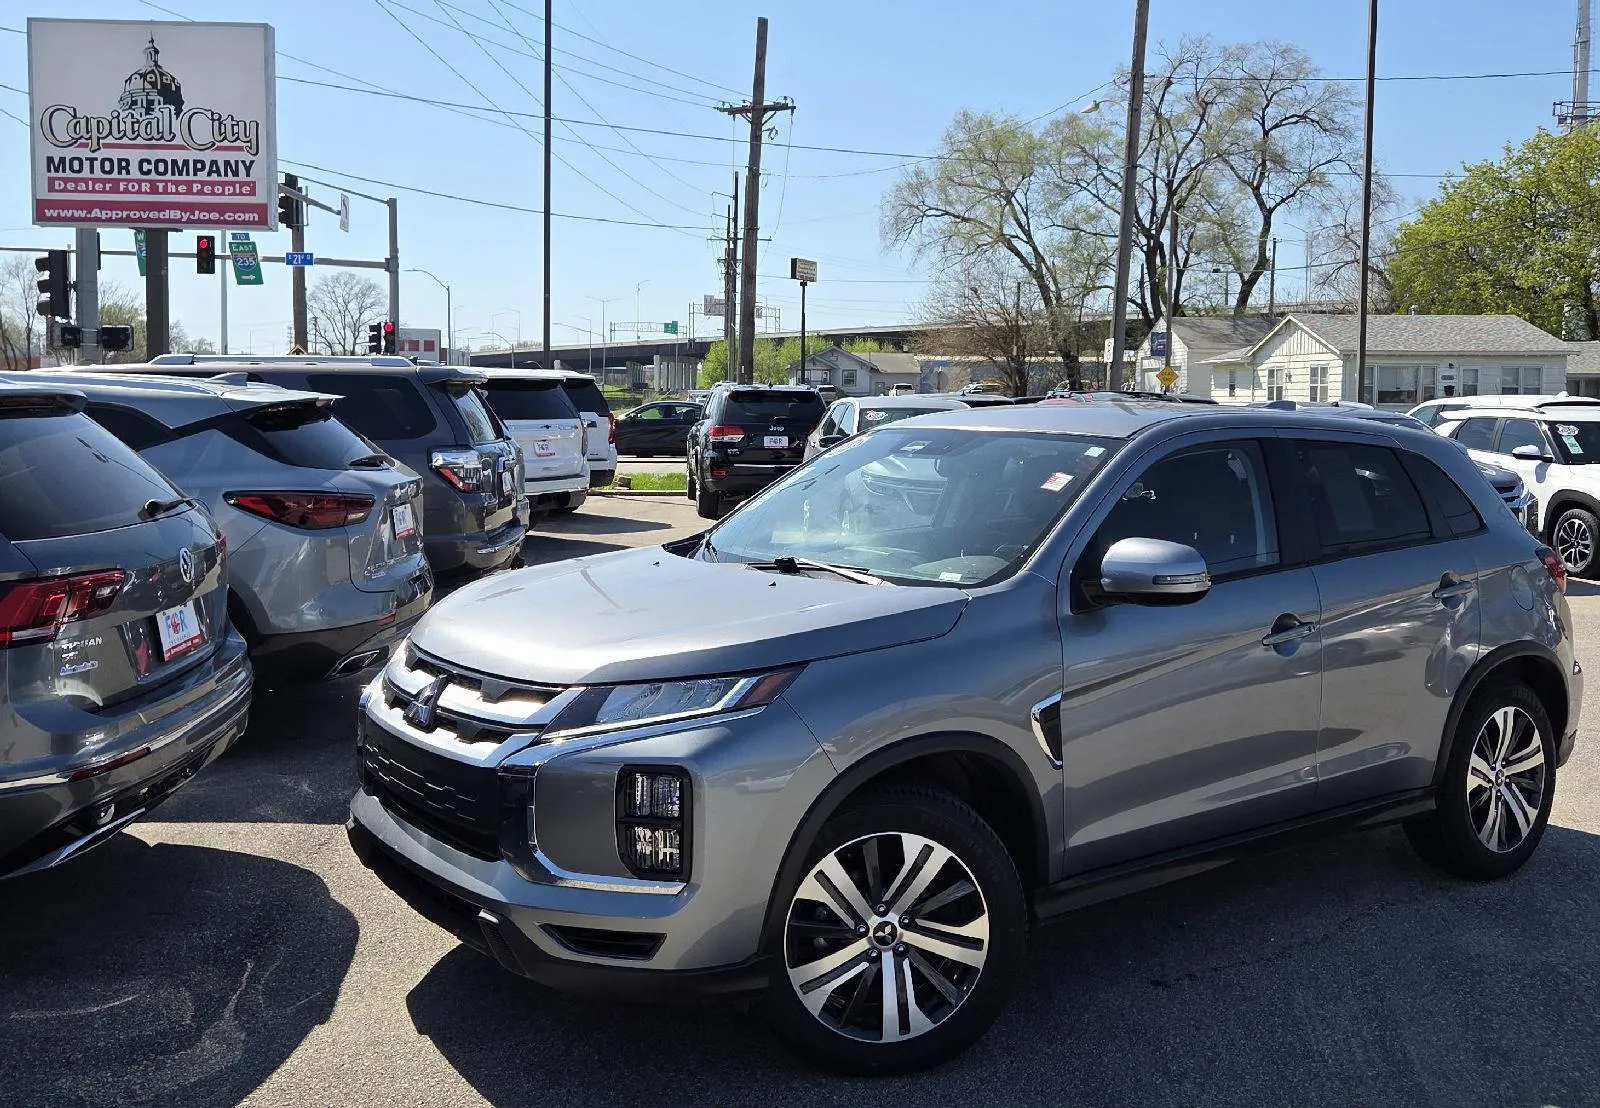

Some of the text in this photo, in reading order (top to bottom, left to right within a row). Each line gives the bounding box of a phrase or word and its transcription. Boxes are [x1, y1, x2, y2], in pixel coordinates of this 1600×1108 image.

[40, 104, 260, 156] Capital City
[46, 156, 255, 178] MOTOR COMPANY
[54, 180, 113, 191] Dealer
[119, 181, 151, 192] FOR
[156, 182, 187, 193] The
[44, 207, 259, 222] www.ApprovedByJoe.com
[232, 243, 253, 252] EAST
[237, 257, 256, 266] 235
